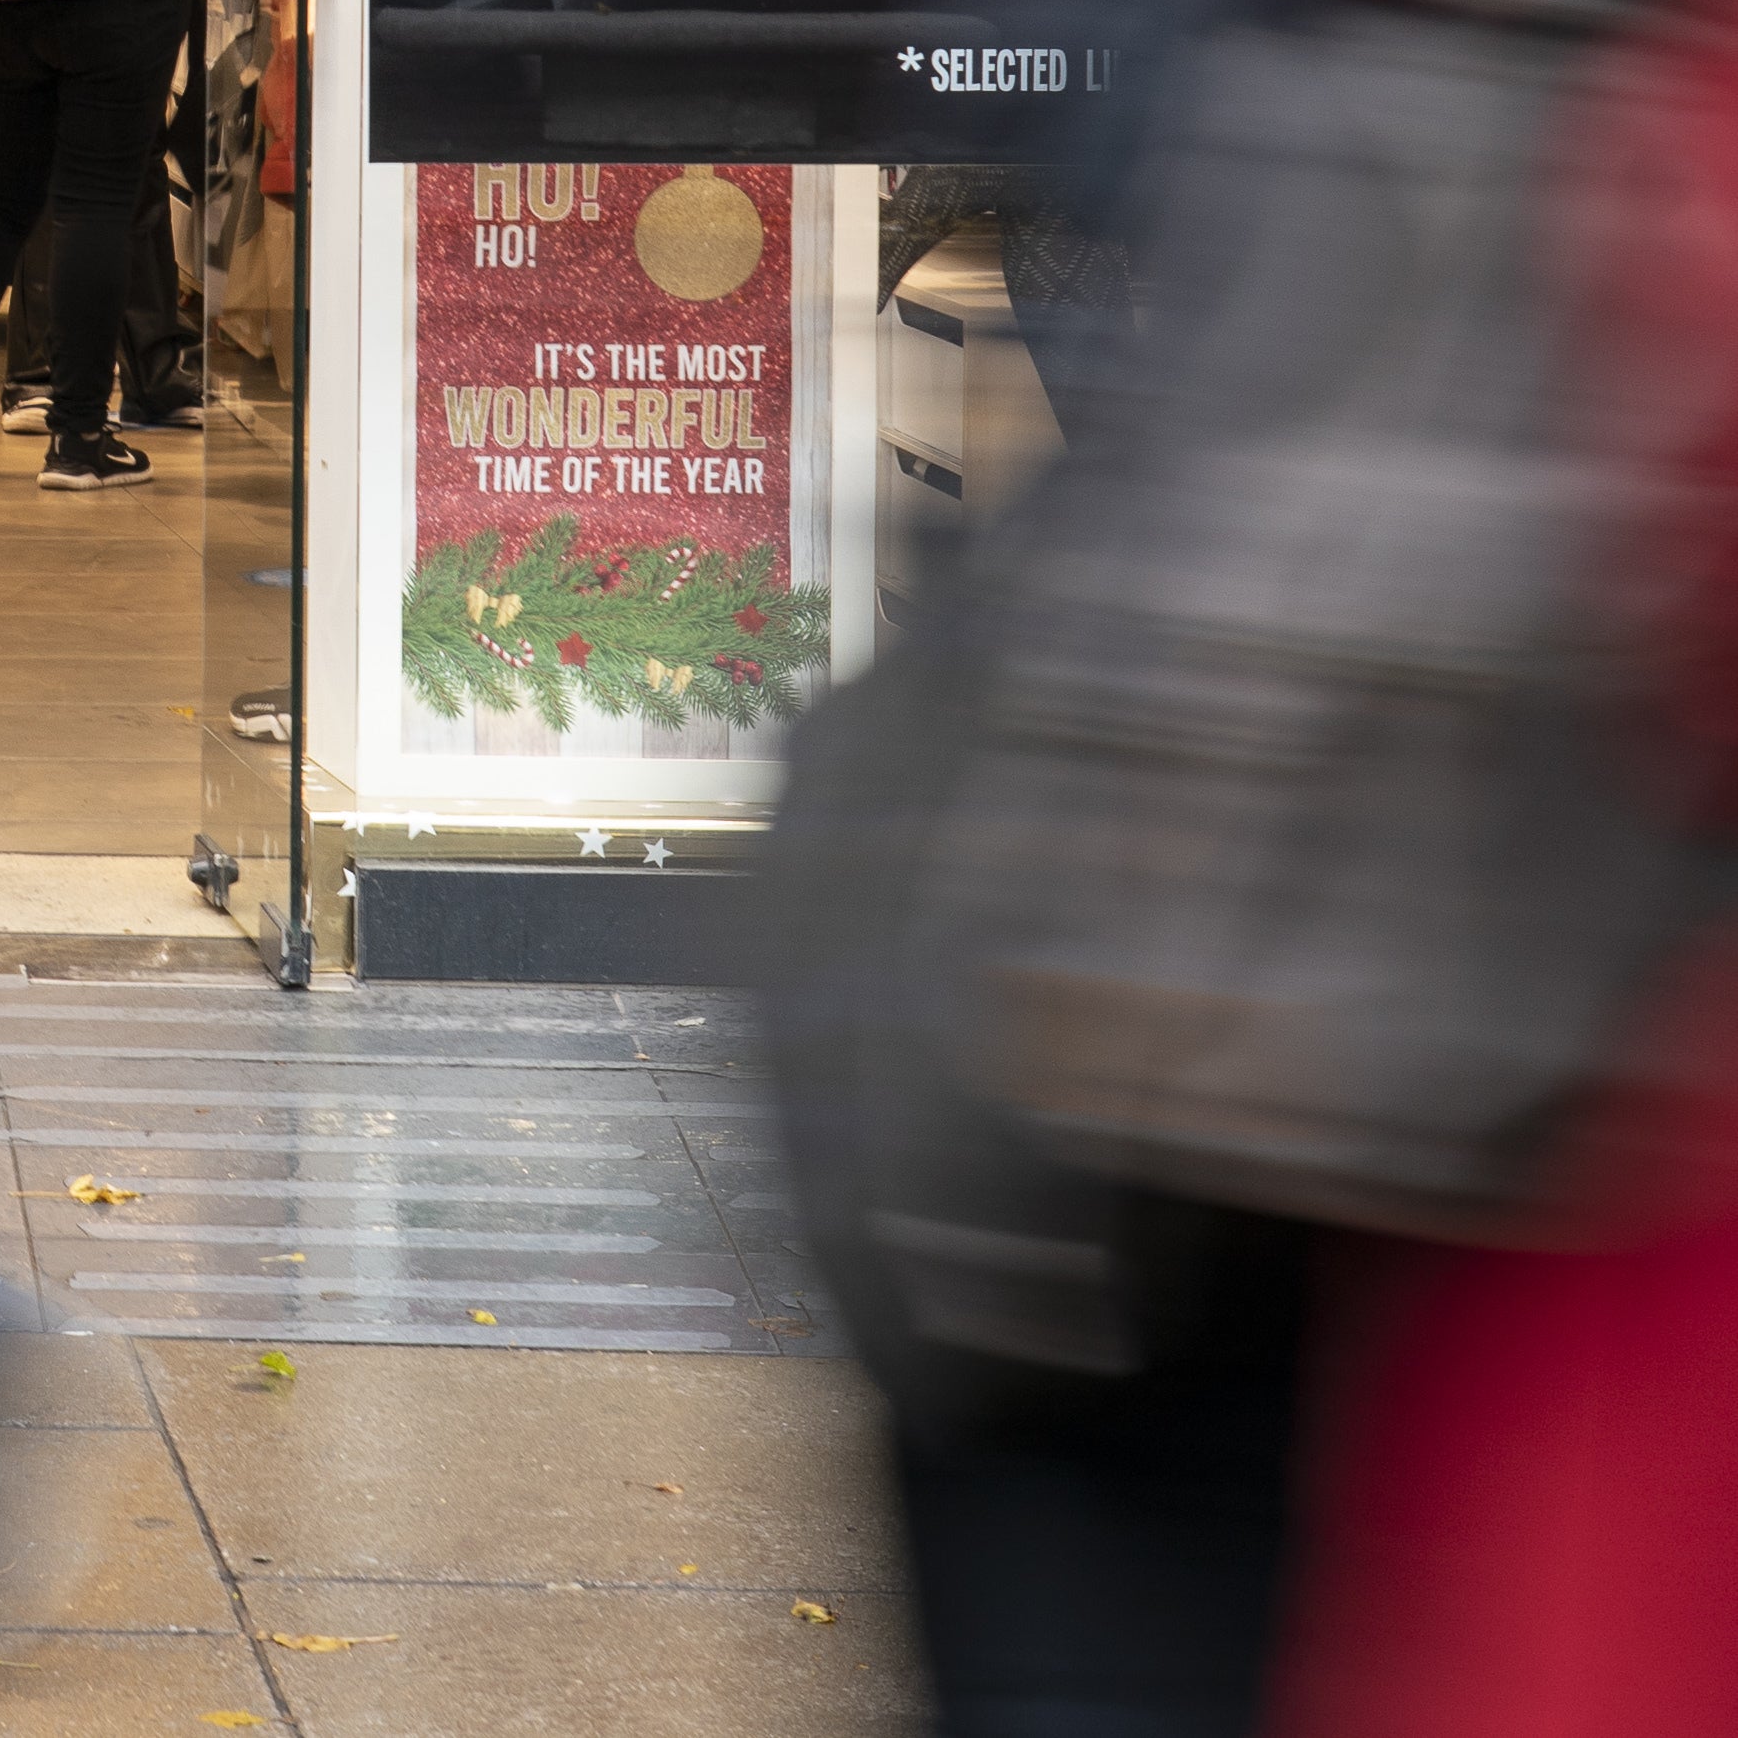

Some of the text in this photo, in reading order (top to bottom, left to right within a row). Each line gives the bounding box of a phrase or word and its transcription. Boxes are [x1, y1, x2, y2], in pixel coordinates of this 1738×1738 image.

[475, 223, 538, 269] HO!
[533, 342, 766, 382] IT'S THE MOST
[443, 385, 767, 450] WONDERFUL
[476, 456, 766, 495] TIME OF THE YEAR
